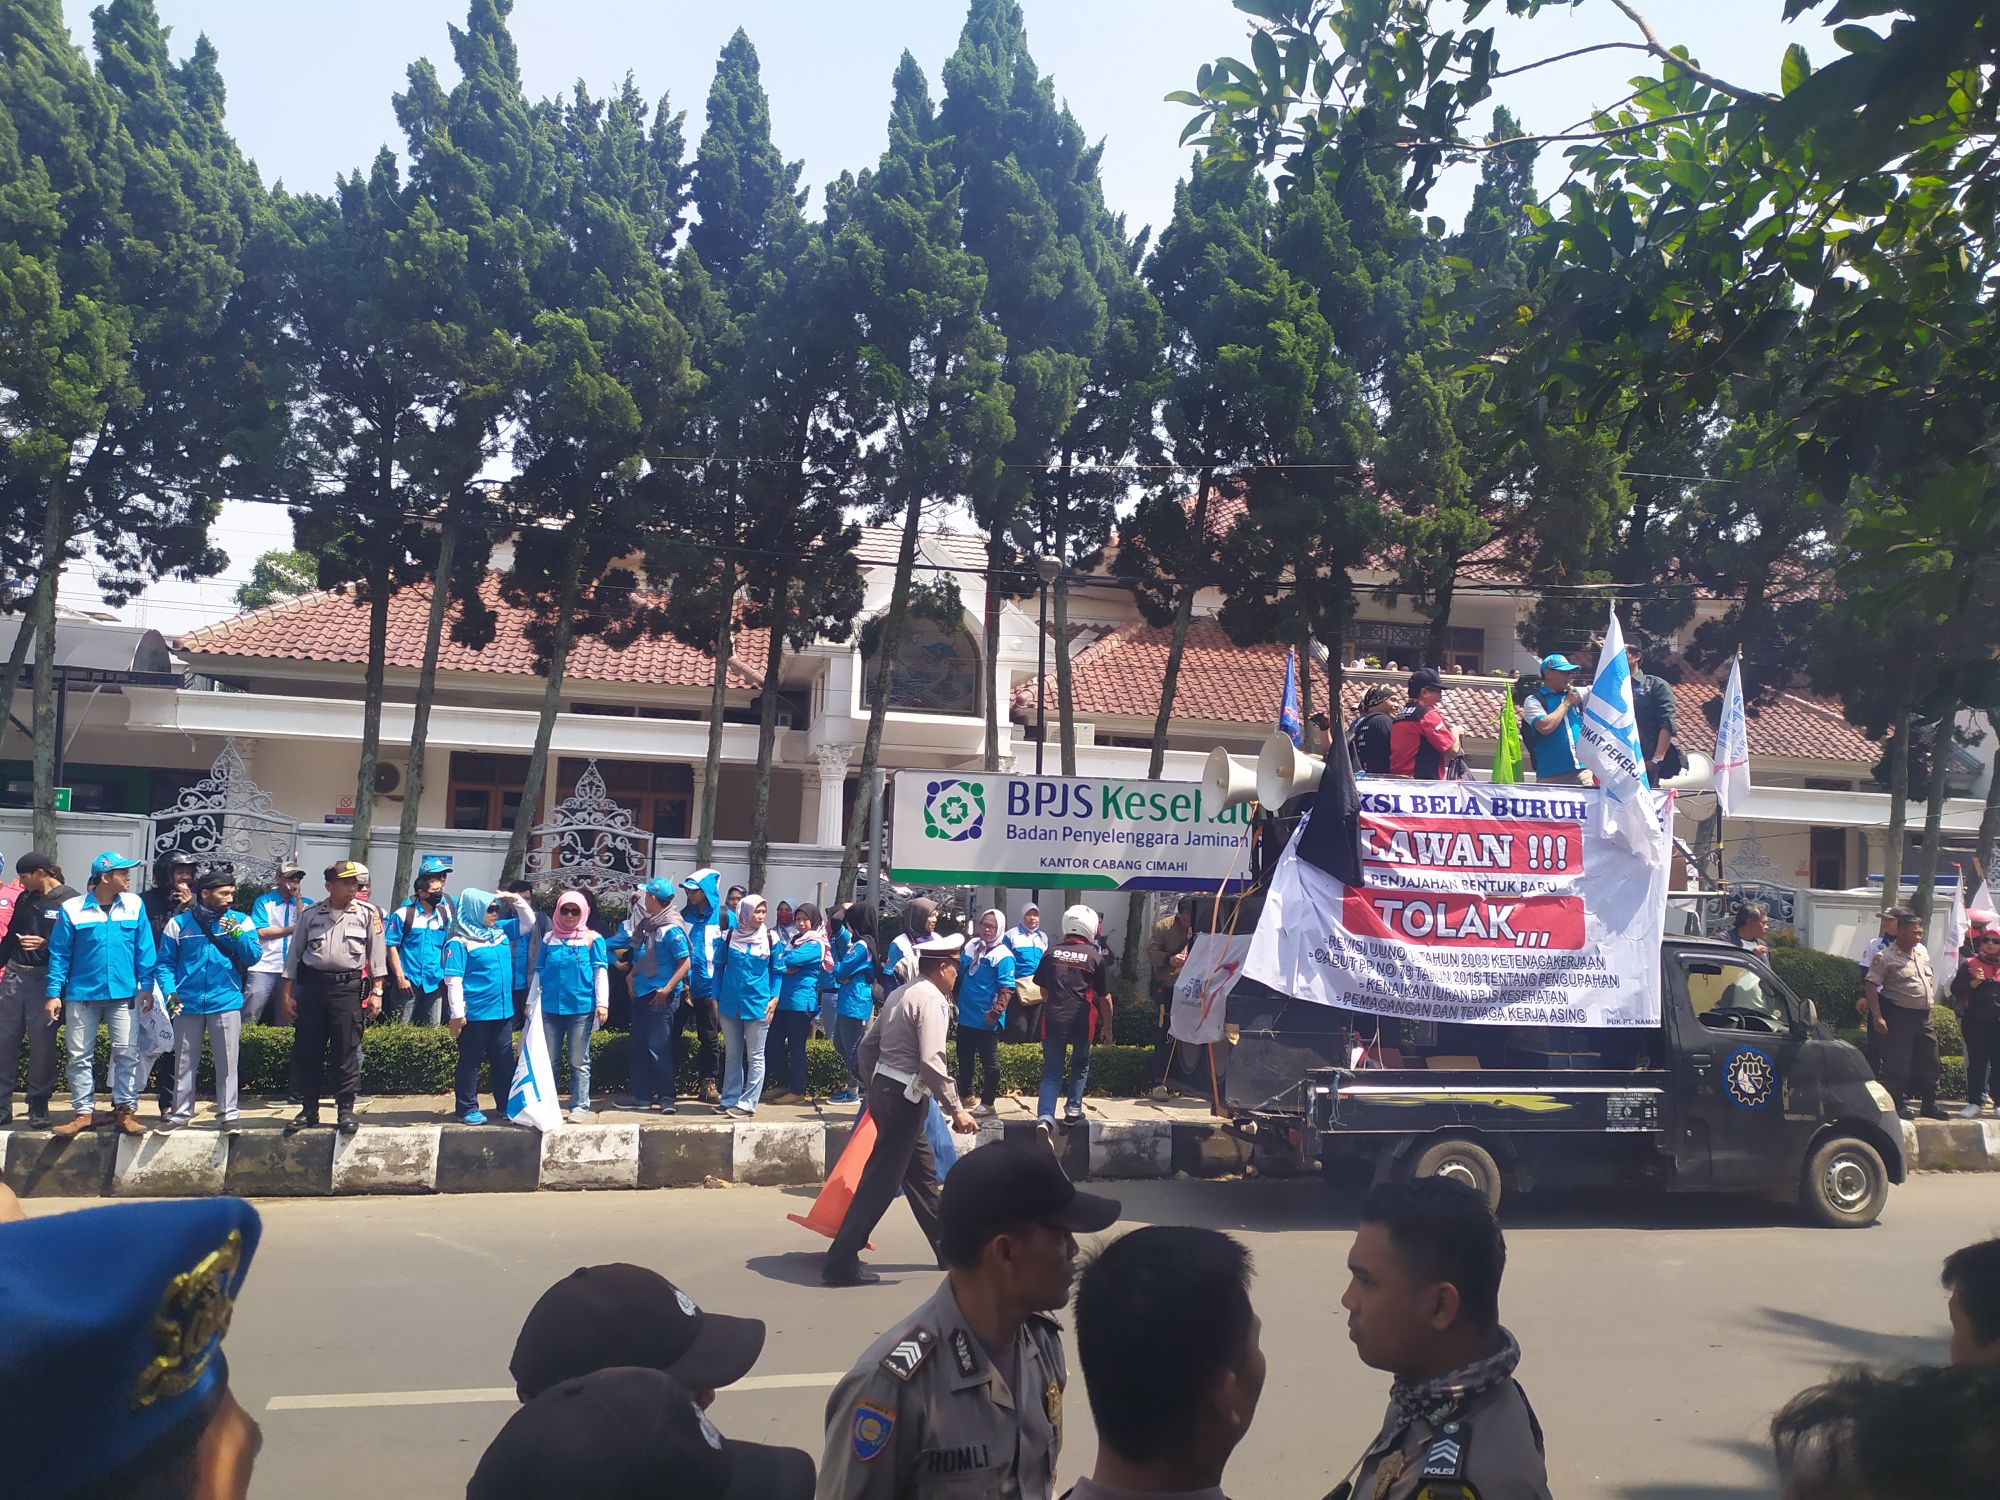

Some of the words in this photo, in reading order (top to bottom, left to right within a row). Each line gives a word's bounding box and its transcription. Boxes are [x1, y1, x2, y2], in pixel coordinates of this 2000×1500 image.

[1602, 743, 1641, 781] PEKERJ
[1007, 780, 1093, 819] BPJS
[1359, 794, 1404, 814] KSI
[1410, 795, 1482, 816] BELA
[1490, 797, 1588, 820] BURUH
[1006, 823, 1058, 842] Badan
[1062, 826, 1179, 848] Penyelenggara
[1184, 831, 1249, 848] Jaminan
[1360, 828, 1514, 868] LAWAN
[1040, 857, 1089, 869] KANTOR
[1092, 859, 1142, 871] CABANG
[1145, 861, 1188, 872] CIMAHI
[1371, 873, 1458, 891] PENJAJAHAN
[1461, 879, 1516, 893] BENTUK
[1520, 881, 1558, 893] BARU
[1461, 953, 1490, 968] 2003
[1491, 954, 1606, 970] KETENAGAKERJAAN
[1376, 962, 1398, 978] NO
[1399, 964, 1414, 979] 78
[1452, 972, 1482, 985] 2015
[1483, 971, 1540, 987] TENTANG
[1538, 973, 1620, 988] PENGUPAHAN
[1470, 989, 1500, 1003] BPJS
[1500, 990, 1569, 1004] KESEHATAN
[1432, 1004, 1460, 1020] DAN
[1460, 1006, 1508, 1022] TENAGA
[1508, 1007, 1548, 1022] KERJA
[1550, 1008, 1588, 1024] ASING
[1635, 1018, 1661, 1026] NAMAS
[927, 1444, 989, 1473] ROMLI
[1423, 1466, 1456, 1476] POLISI
